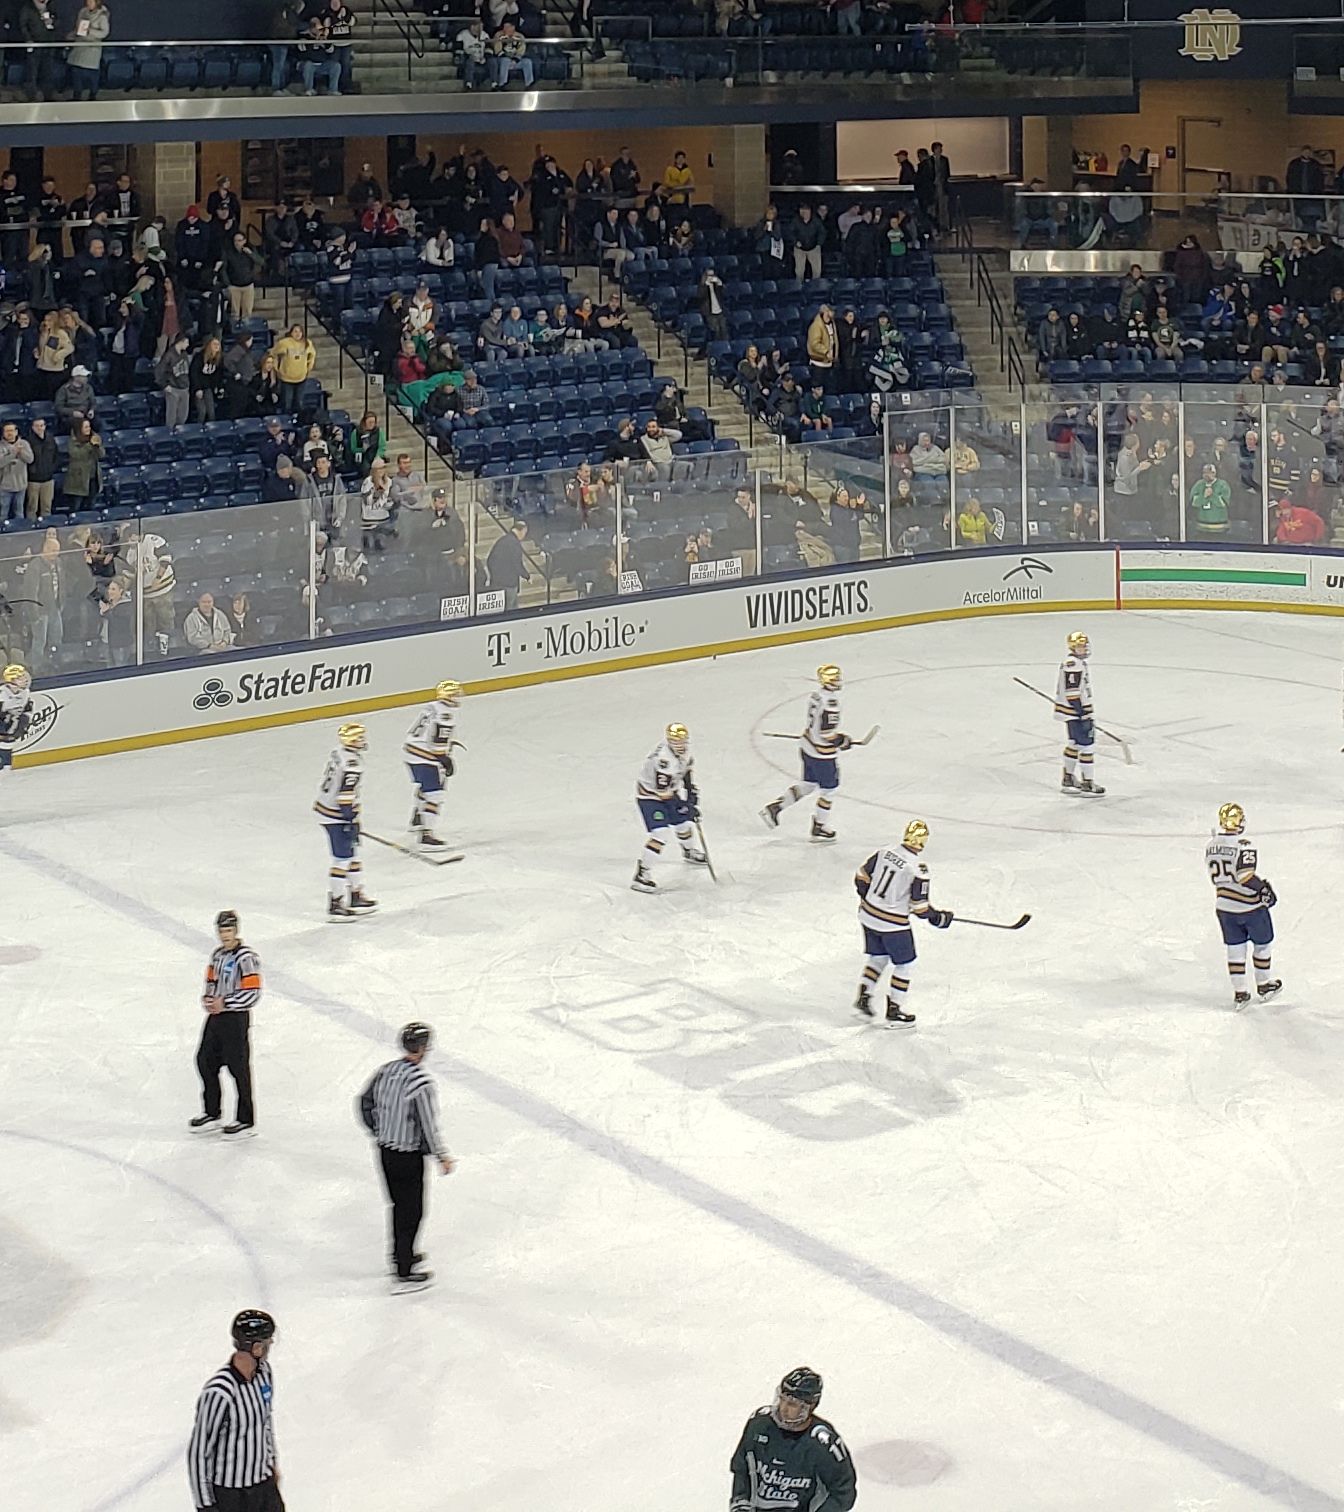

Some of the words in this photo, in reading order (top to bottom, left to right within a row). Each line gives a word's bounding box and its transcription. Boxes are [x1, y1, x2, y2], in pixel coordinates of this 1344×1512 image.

[486, 593, 497, 602] GO
[963, 585, 1043, 605] ArcelorMittal
[479, 600, 503, 612] IRISH!
[1243, 851, 1256, 864] 25
[1209, 859, 1240, 885] 25
[874, 866, 896, 899] 11
